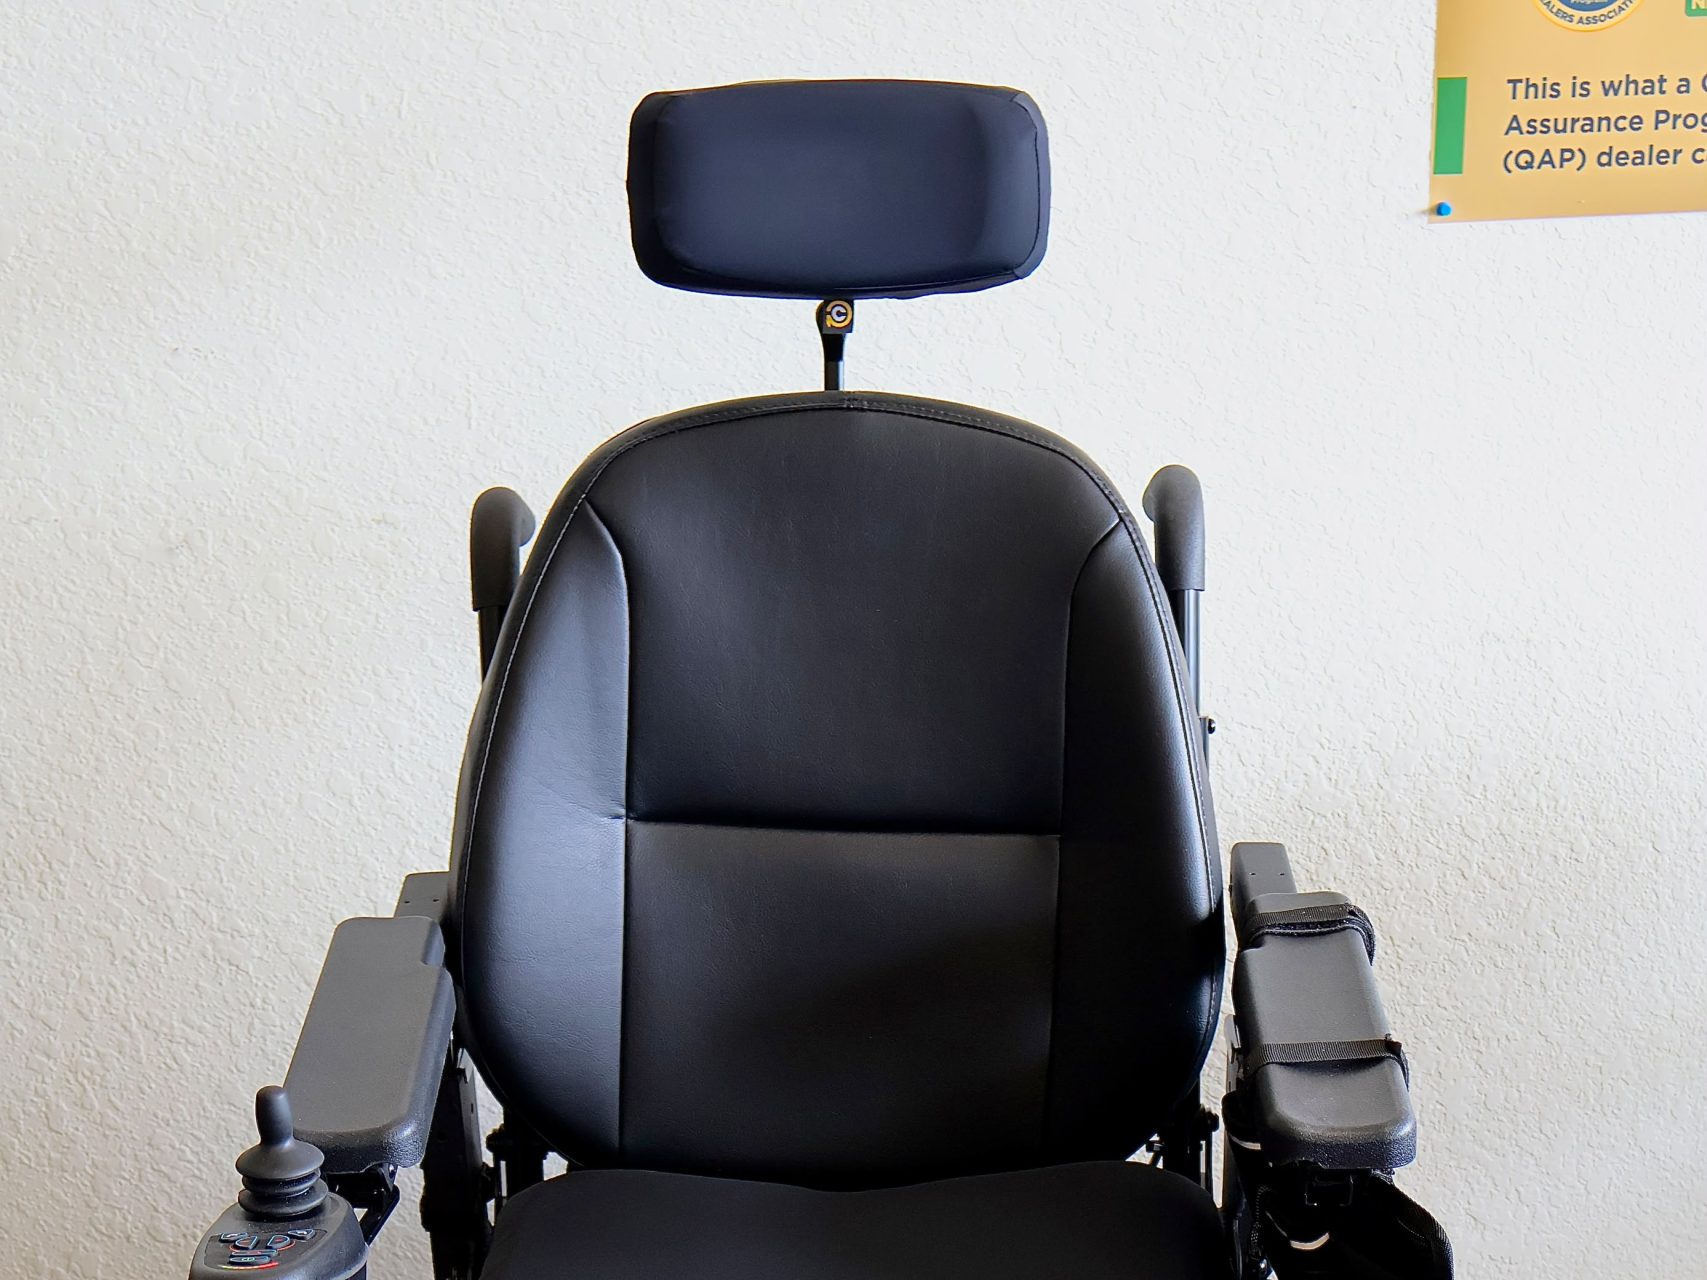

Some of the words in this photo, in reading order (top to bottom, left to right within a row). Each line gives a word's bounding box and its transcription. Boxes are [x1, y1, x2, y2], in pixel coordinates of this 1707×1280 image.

[1506, 76, 1561, 99] This
[1571, 75, 1591, 98] is
[1601, 73, 1667, 96] what
[1676, 77, 1690, 94] a
[1504, 114, 1643, 136] Assurance
[1503, 147, 1586, 174] (QAP)
[1597, 144, 1683, 167] dealer
[1691, 147, 1707, 164] c
